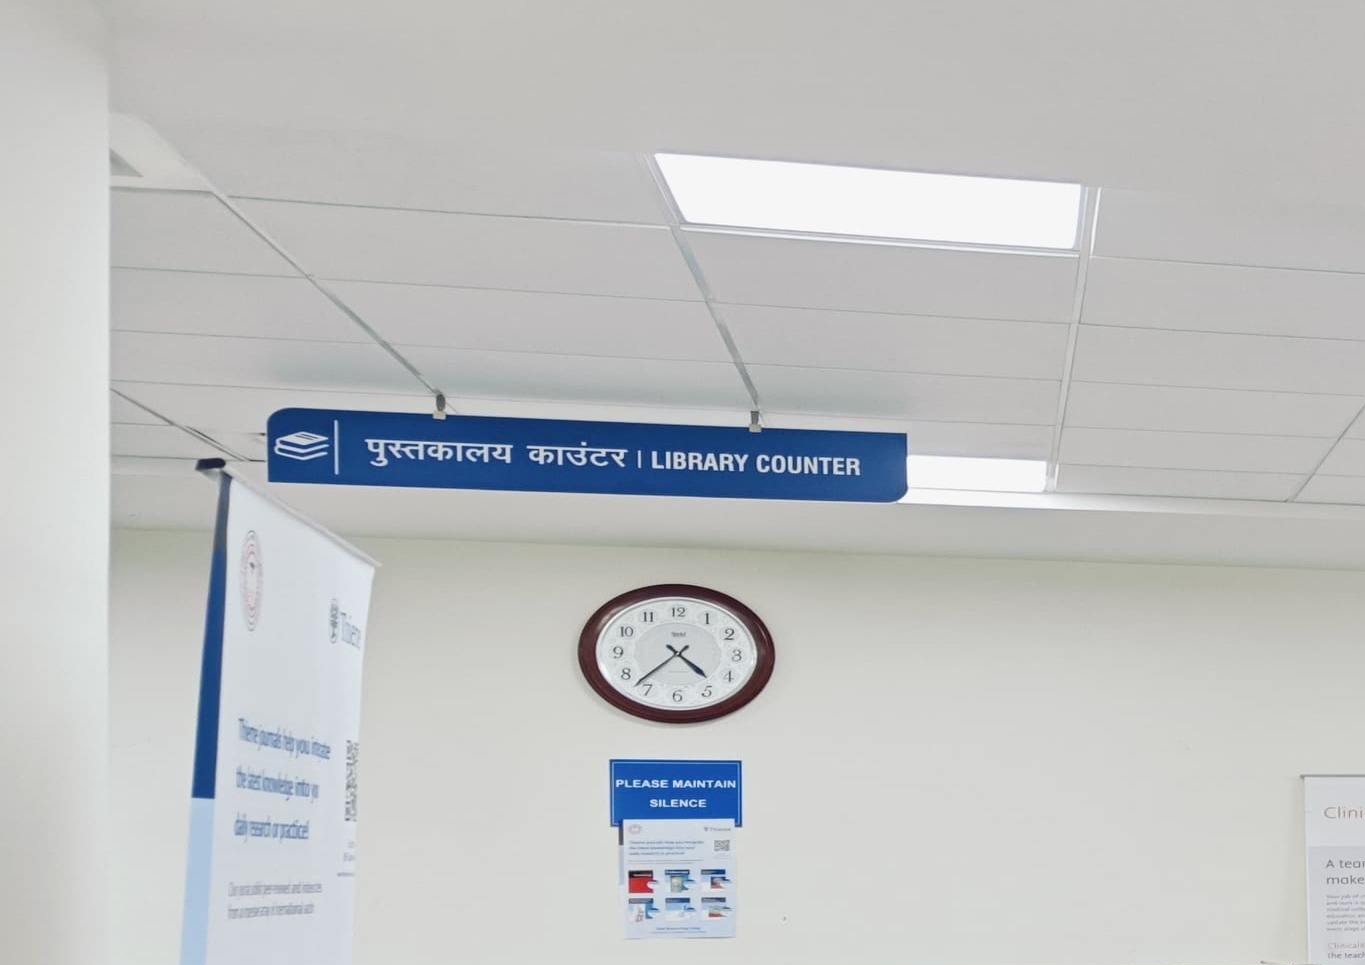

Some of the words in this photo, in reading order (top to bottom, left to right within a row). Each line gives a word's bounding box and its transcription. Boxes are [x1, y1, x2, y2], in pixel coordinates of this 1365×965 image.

[365, 437, 512, 467] पुस्तकालय
[527, 440, 628, 468] काउंटर
[651, 450, 749, 473] LIBRARY
[756, 454, 861, 477] COUNTER
[643, 611, 654, 623] 11
[671, 607, 686, 618] 12
[705, 612, 710, 625] 1
[620, 626, 634, 638] 10
[724, 628, 735, 641] 2
[612, 646, 624, 659] 9
[731, 649, 742, 662] 3
[620, 667, 632, 680] 8
[723, 670, 734, 683] 4
[642, 683, 653, 697] 7
[672, 689, 683, 702] 6
[701, 685, 713, 698] 5
[615, 778, 669, 790] PLEASE
[673, 779, 737, 791] MAINTAIN
[649, 797, 708, 809] SILENCE
[1326, 859, 1335, 869] A
[1328, 951, 1342, 959] the
